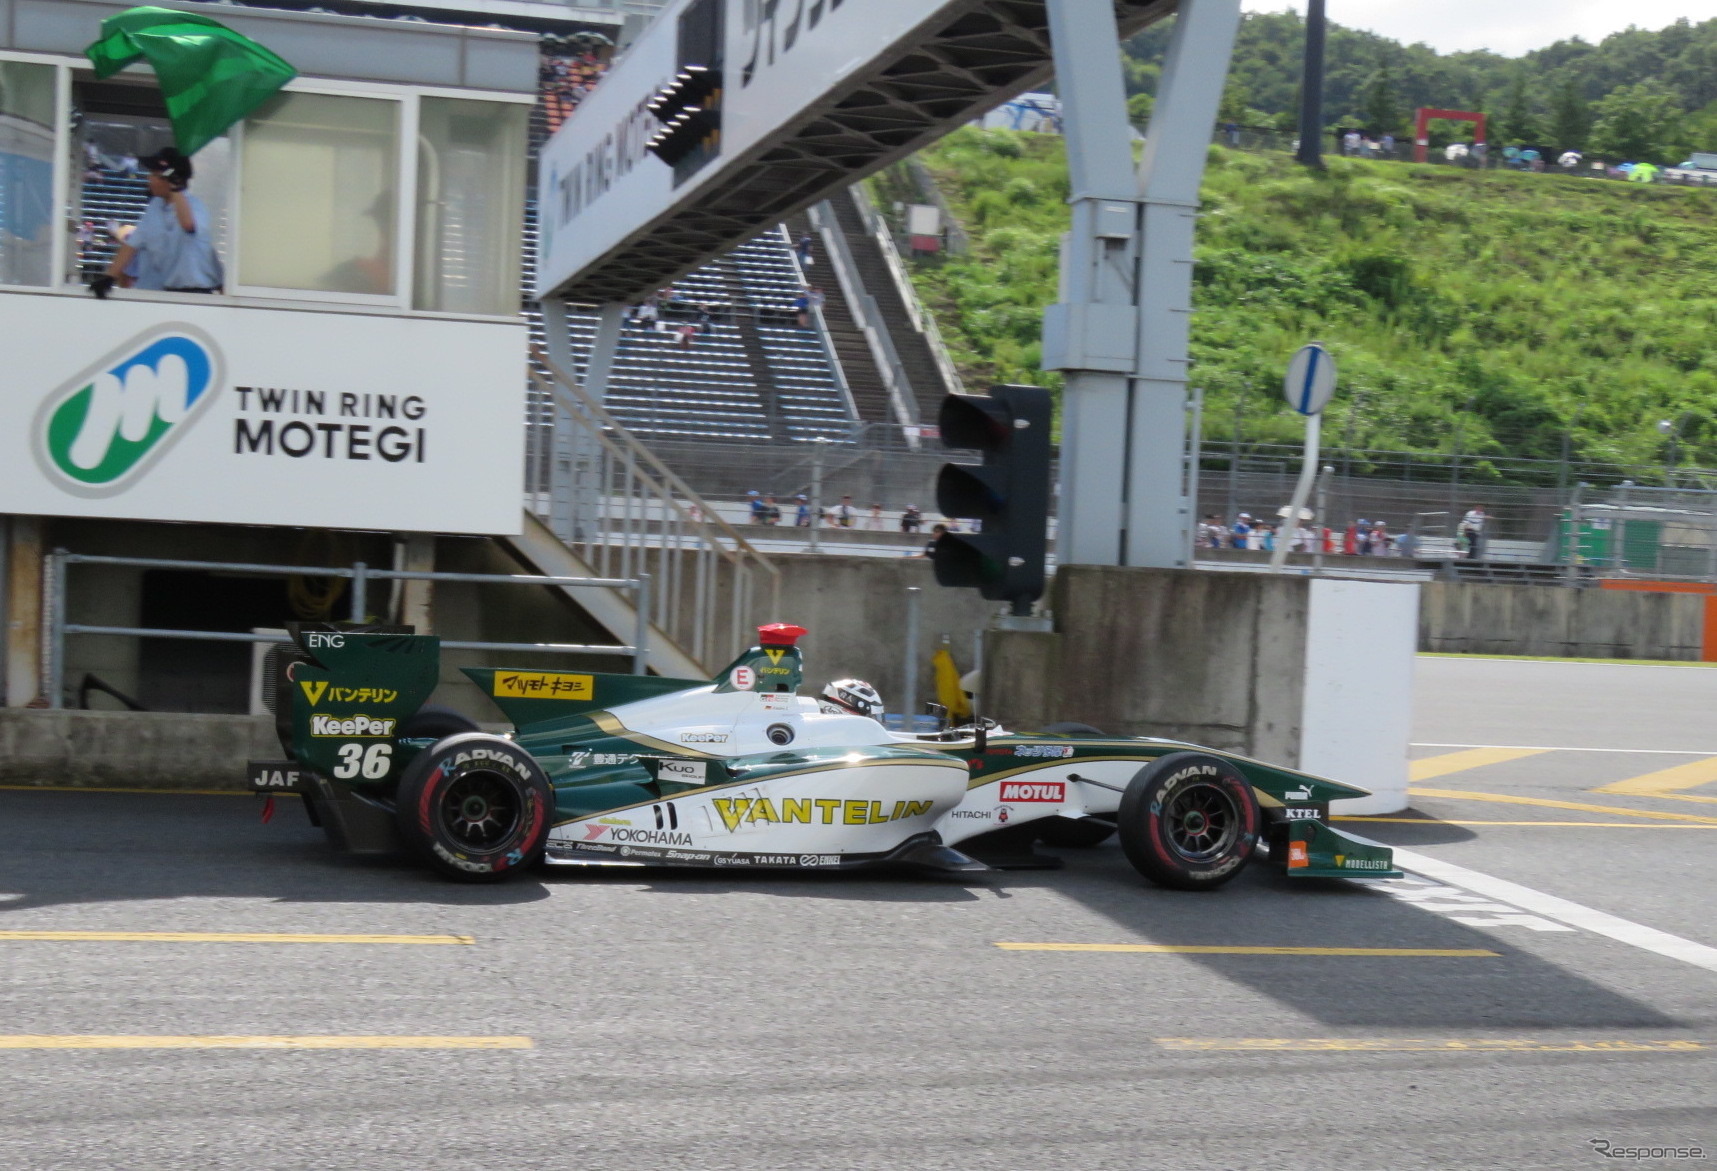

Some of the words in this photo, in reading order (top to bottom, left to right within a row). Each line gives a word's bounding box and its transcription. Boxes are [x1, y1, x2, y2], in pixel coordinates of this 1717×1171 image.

[234, 386, 325, 415] TWIN
[340, 392, 427, 420] RING
[234, 418, 425, 463] MOTEGI
[309, 634, 345, 648] ENG
[736, 669, 749, 685] E
[328, 687, 398, 703] バンテリン
[311, 715, 395, 736] KeePer
[333, 743, 393, 780] 36
[454, 749, 532, 780] ADVAN
[255, 770, 299, 787] JAF
[1156, 765, 1218, 804] ADVAN
[1002, 785, 1063, 799] MOTUL
[712, 798, 934, 833] VANTELIN
[951, 811, 992, 819] HITACHI
[610, 827, 693, 847] YOKOHAMA
[666, 850, 710, 861] Snap-on
[753, 855, 797, 865] TAKATA
